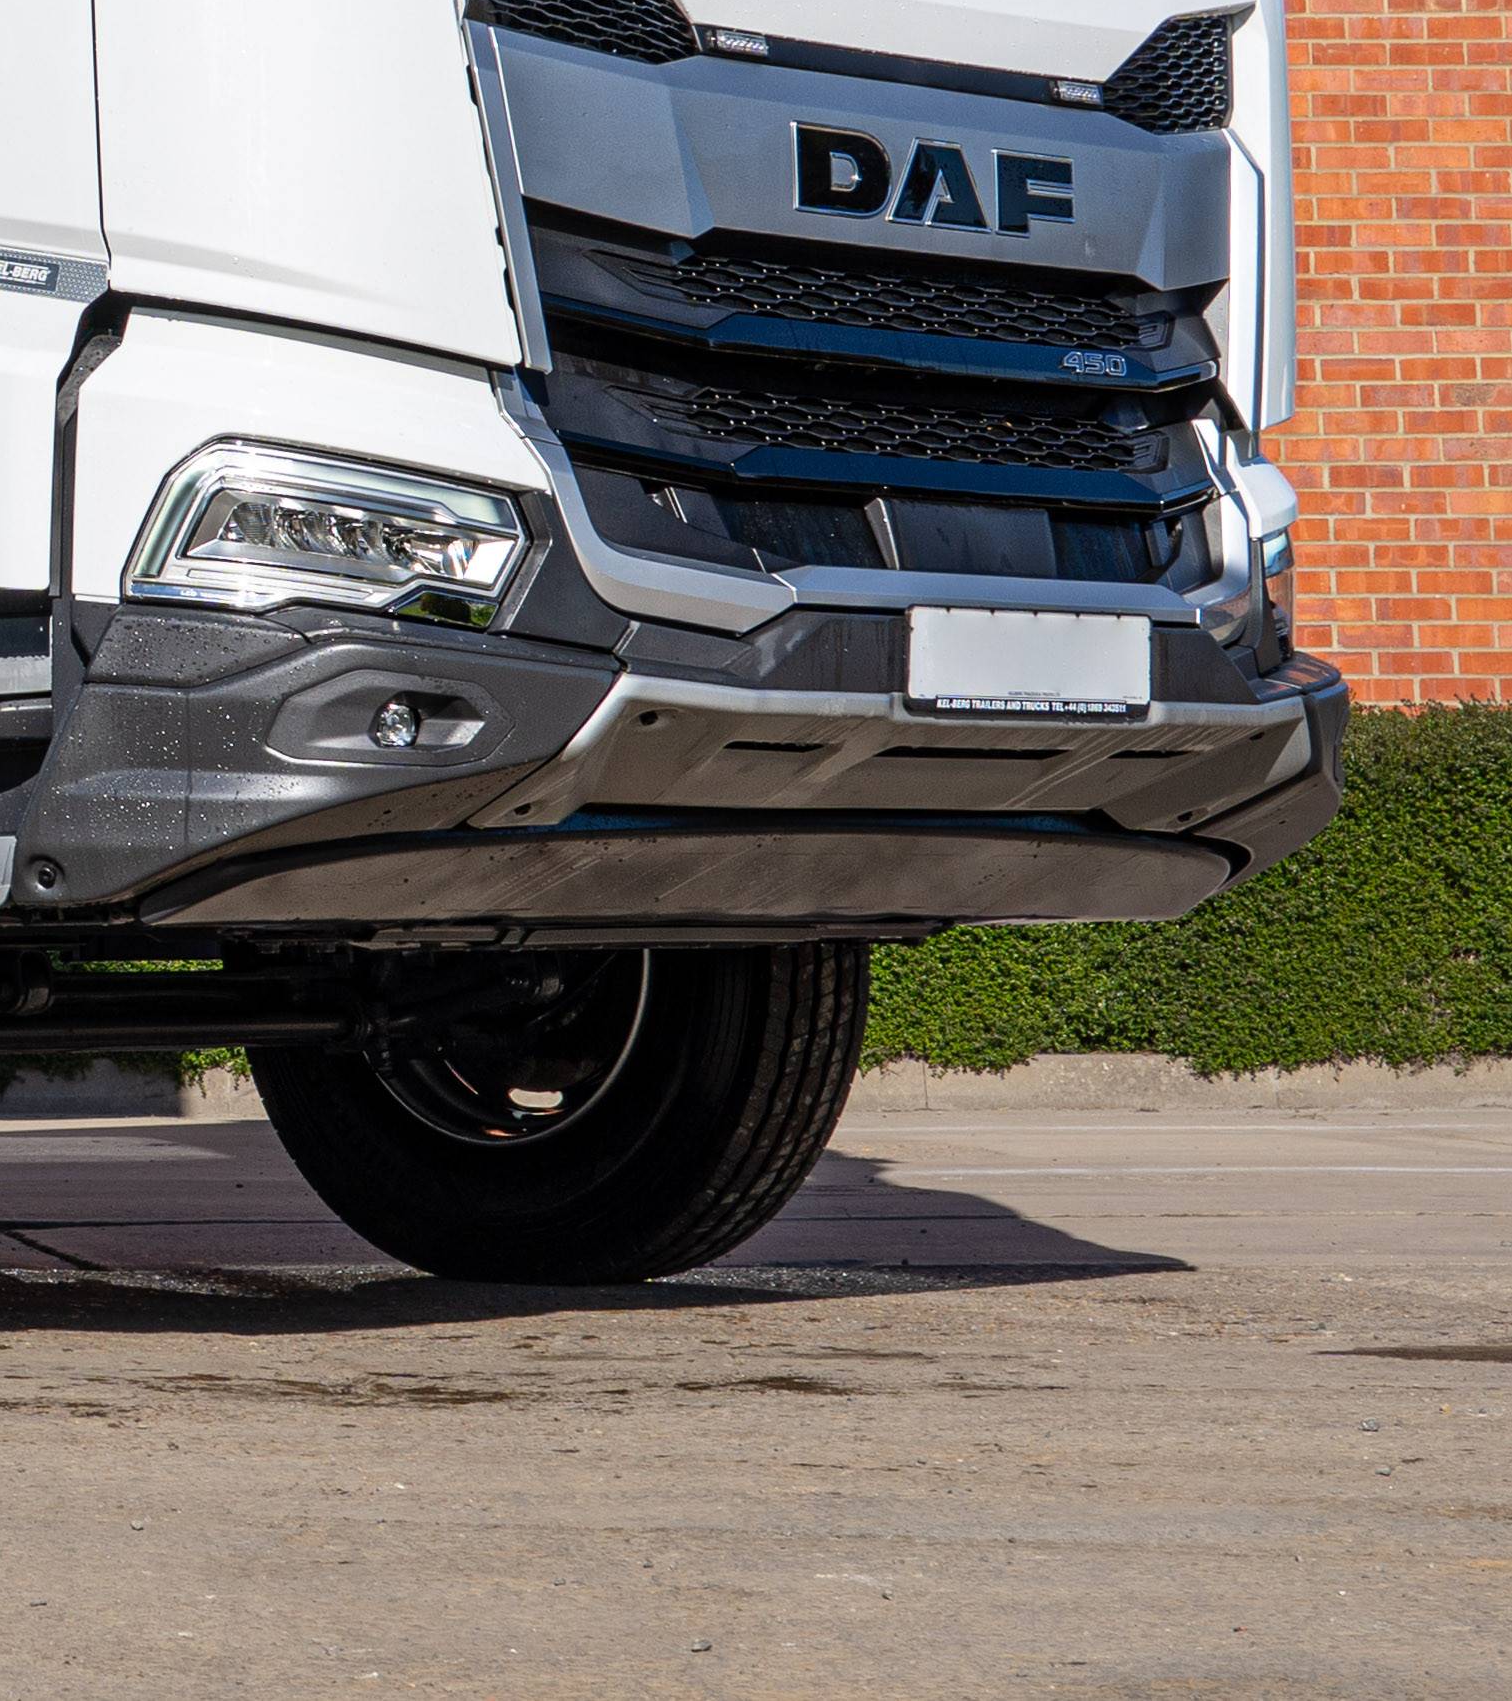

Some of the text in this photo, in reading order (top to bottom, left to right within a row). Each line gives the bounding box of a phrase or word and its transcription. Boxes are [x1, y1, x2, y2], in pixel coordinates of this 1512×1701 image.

[790, 120, 1075, 238] DAF
[1063, 351, 1127, 376] 450
[972, 699, 1006, 710] TRAILERS
[1006, 700, 1022, 711] AND
[1022, 701, 1050, 711] TRUCKS
